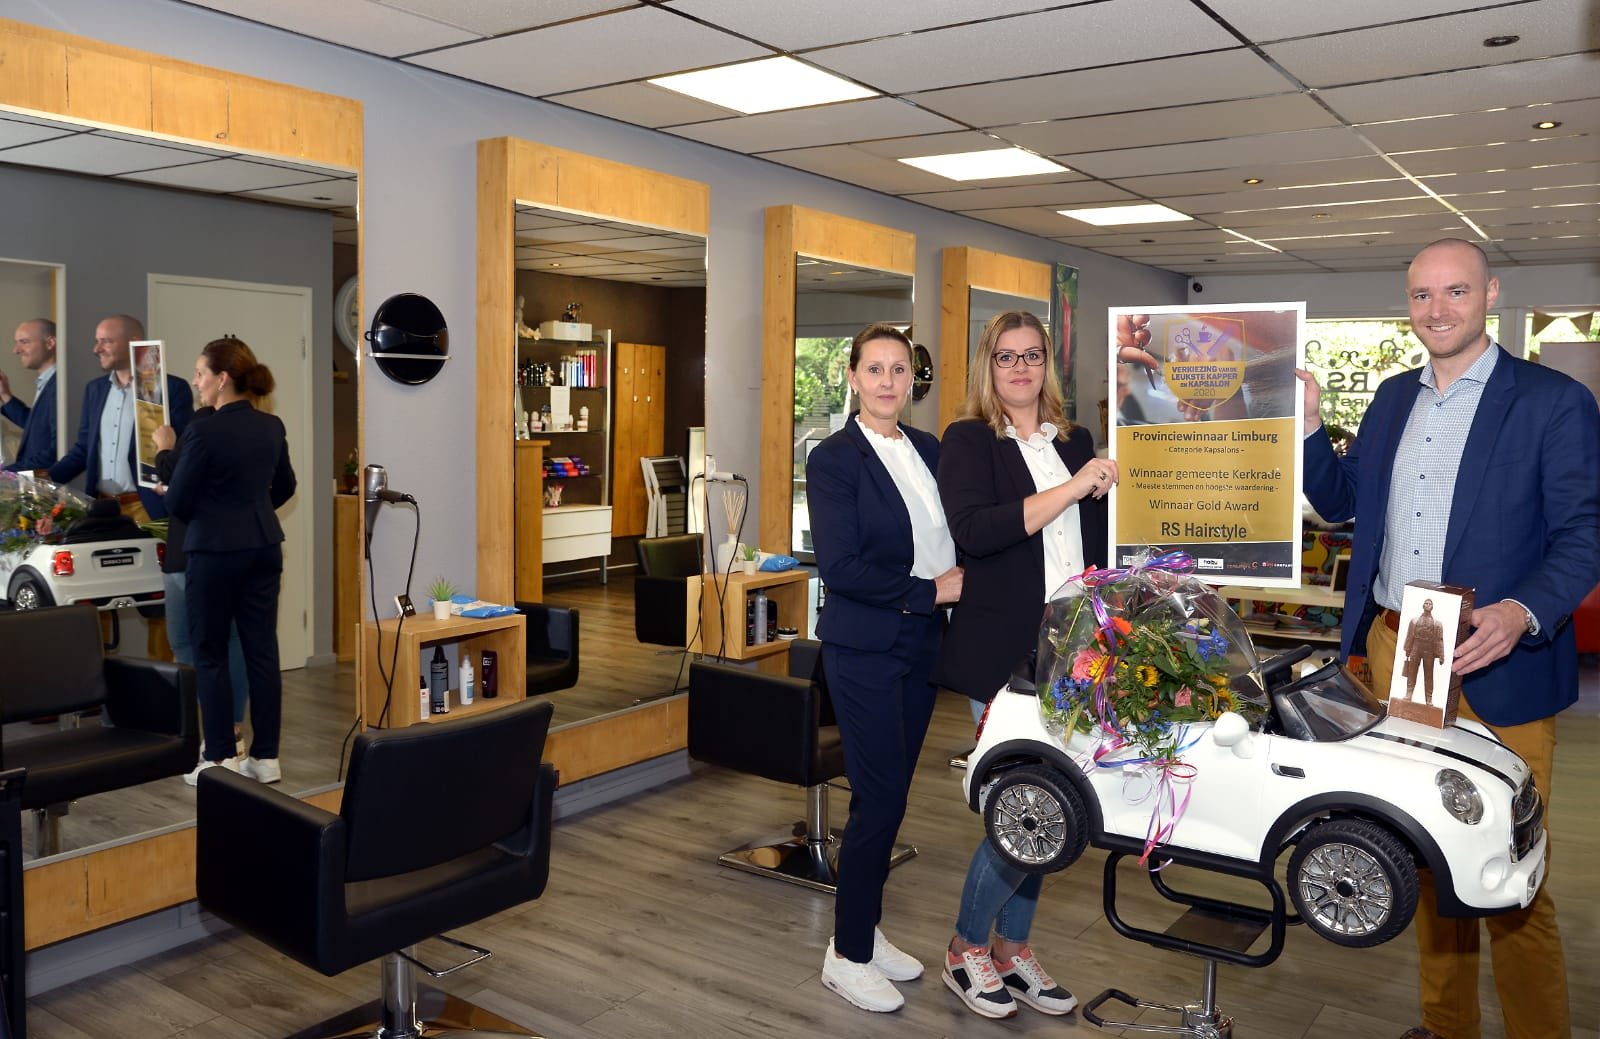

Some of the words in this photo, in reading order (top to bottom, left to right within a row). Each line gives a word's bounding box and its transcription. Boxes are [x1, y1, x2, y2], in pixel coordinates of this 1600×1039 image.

[1133, 432, 1228, 441] Provinciewinnaar
[1232, 432, 1278, 444] Limburg
[1169, 446, 1202, 454] Categorie
[1204, 446, 1239, 454] Kapsalons
[1129, 468, 1173, 478] Winnaar
[1176, 470, 1229, 480] gemeente
[1233, 469, 1281, 480] Kerkrade
[1234, 484, 1274, 492] waardering
[1150, 500, 1193, 510] Winnaar
[1197, 501, 1221, 510] Gold
[1225, 501, 1259, 511] Award
[1162, 522, 1180, 536] RS
[1185, 523, 1247, 541] Hairstyle
